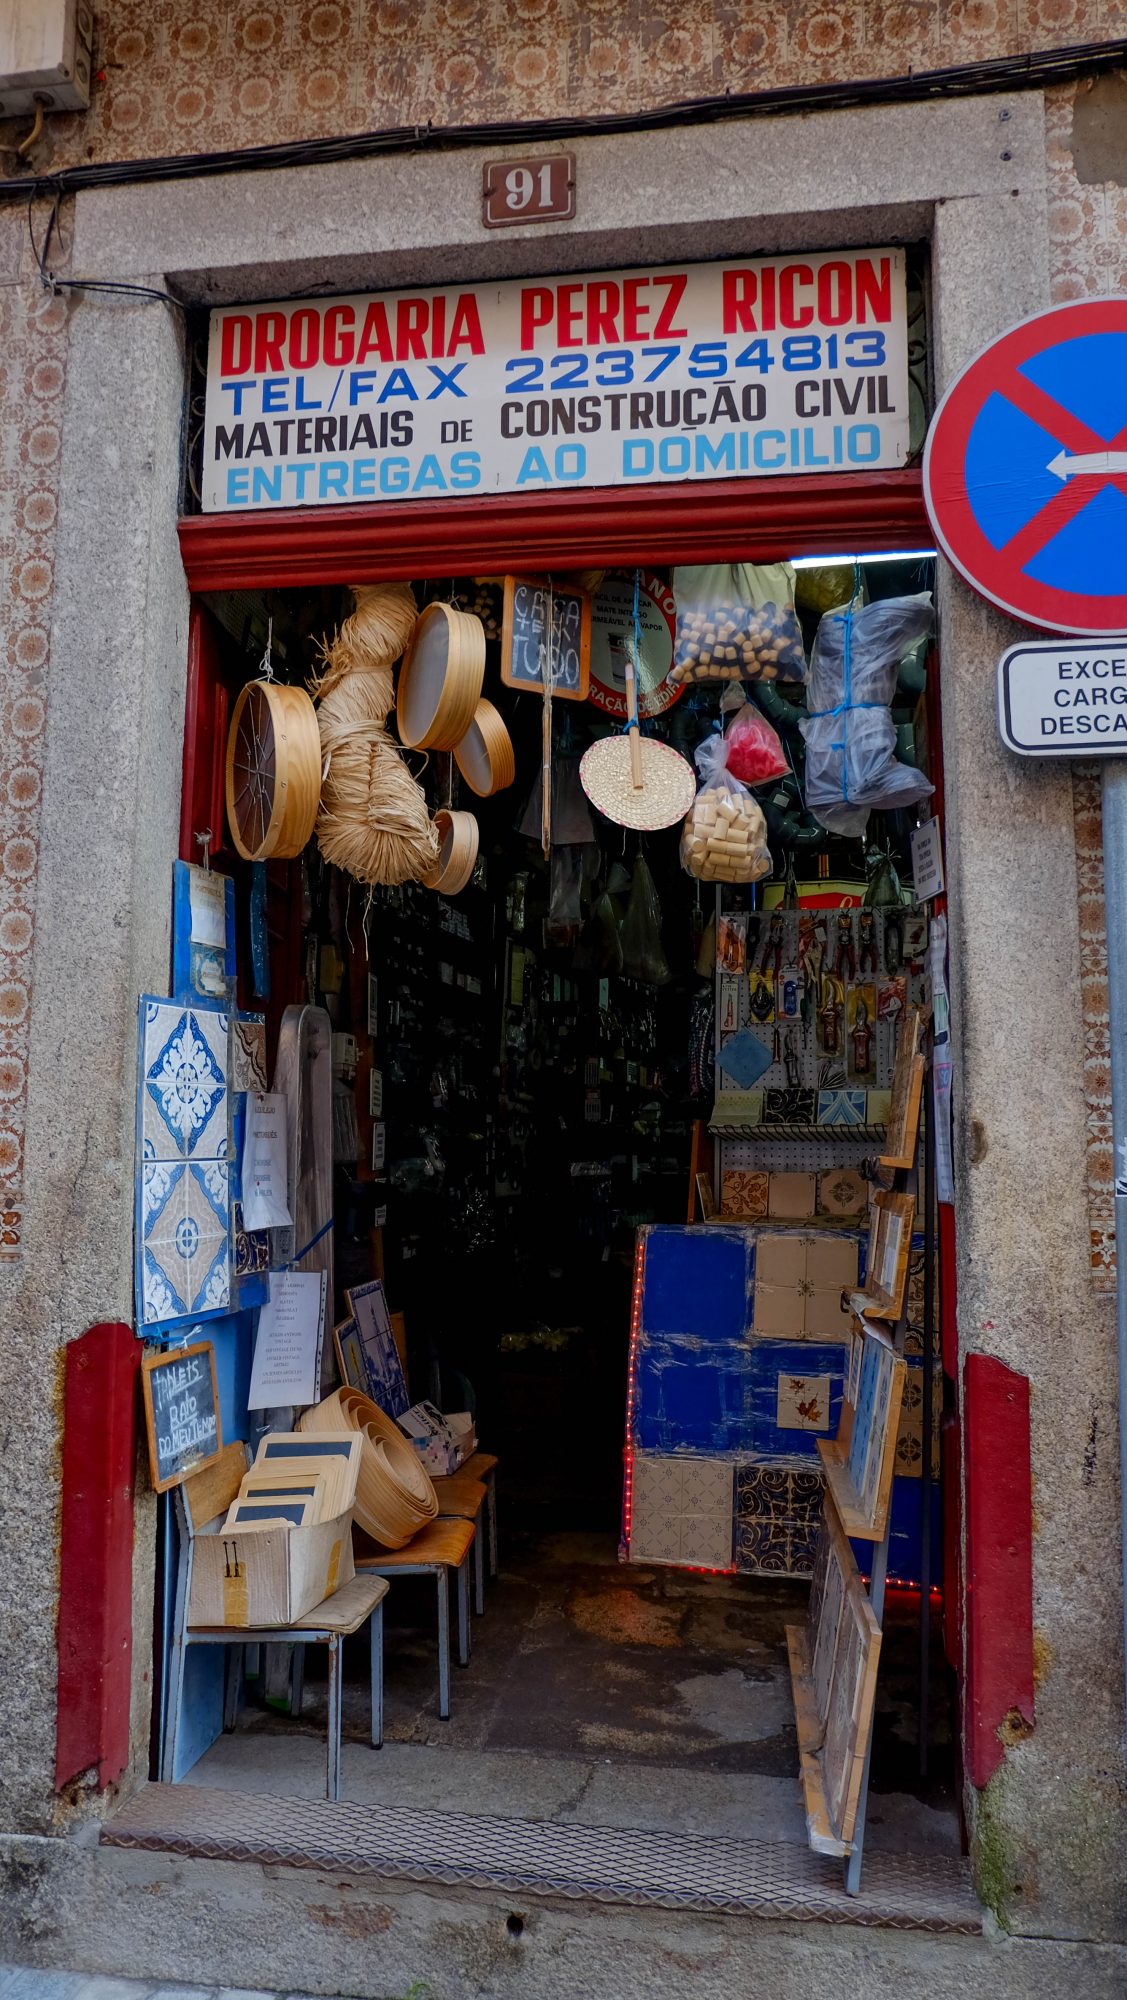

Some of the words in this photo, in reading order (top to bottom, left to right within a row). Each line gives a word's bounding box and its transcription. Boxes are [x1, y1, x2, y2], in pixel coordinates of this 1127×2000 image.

[506, 165, 553, 209] 91
[220, 293, 486, 377] DROGARIA
[521, 274, 688, 351] PEREZ
[723, 257, 892, 334] RICON
[221, 362, 469, 416] TEL/FAX
[505, 330, 886, 394] 223754813
[214, 410, 414, 461] MATERIAIS
[441, 419, 473, 444] DE
[500, 380, 767, 439] CONSTRUÇÃO
[795, 375, 896, 418] CIVIL
[226, 451, 482, 505] ENTREGAS
[516, 443, 587, 484] AO
[623, 423, 881, 477] DOMICILIO
[1053, 685, 1127, 708] CARG
[1058, 658, 1127, 680] EXCE
